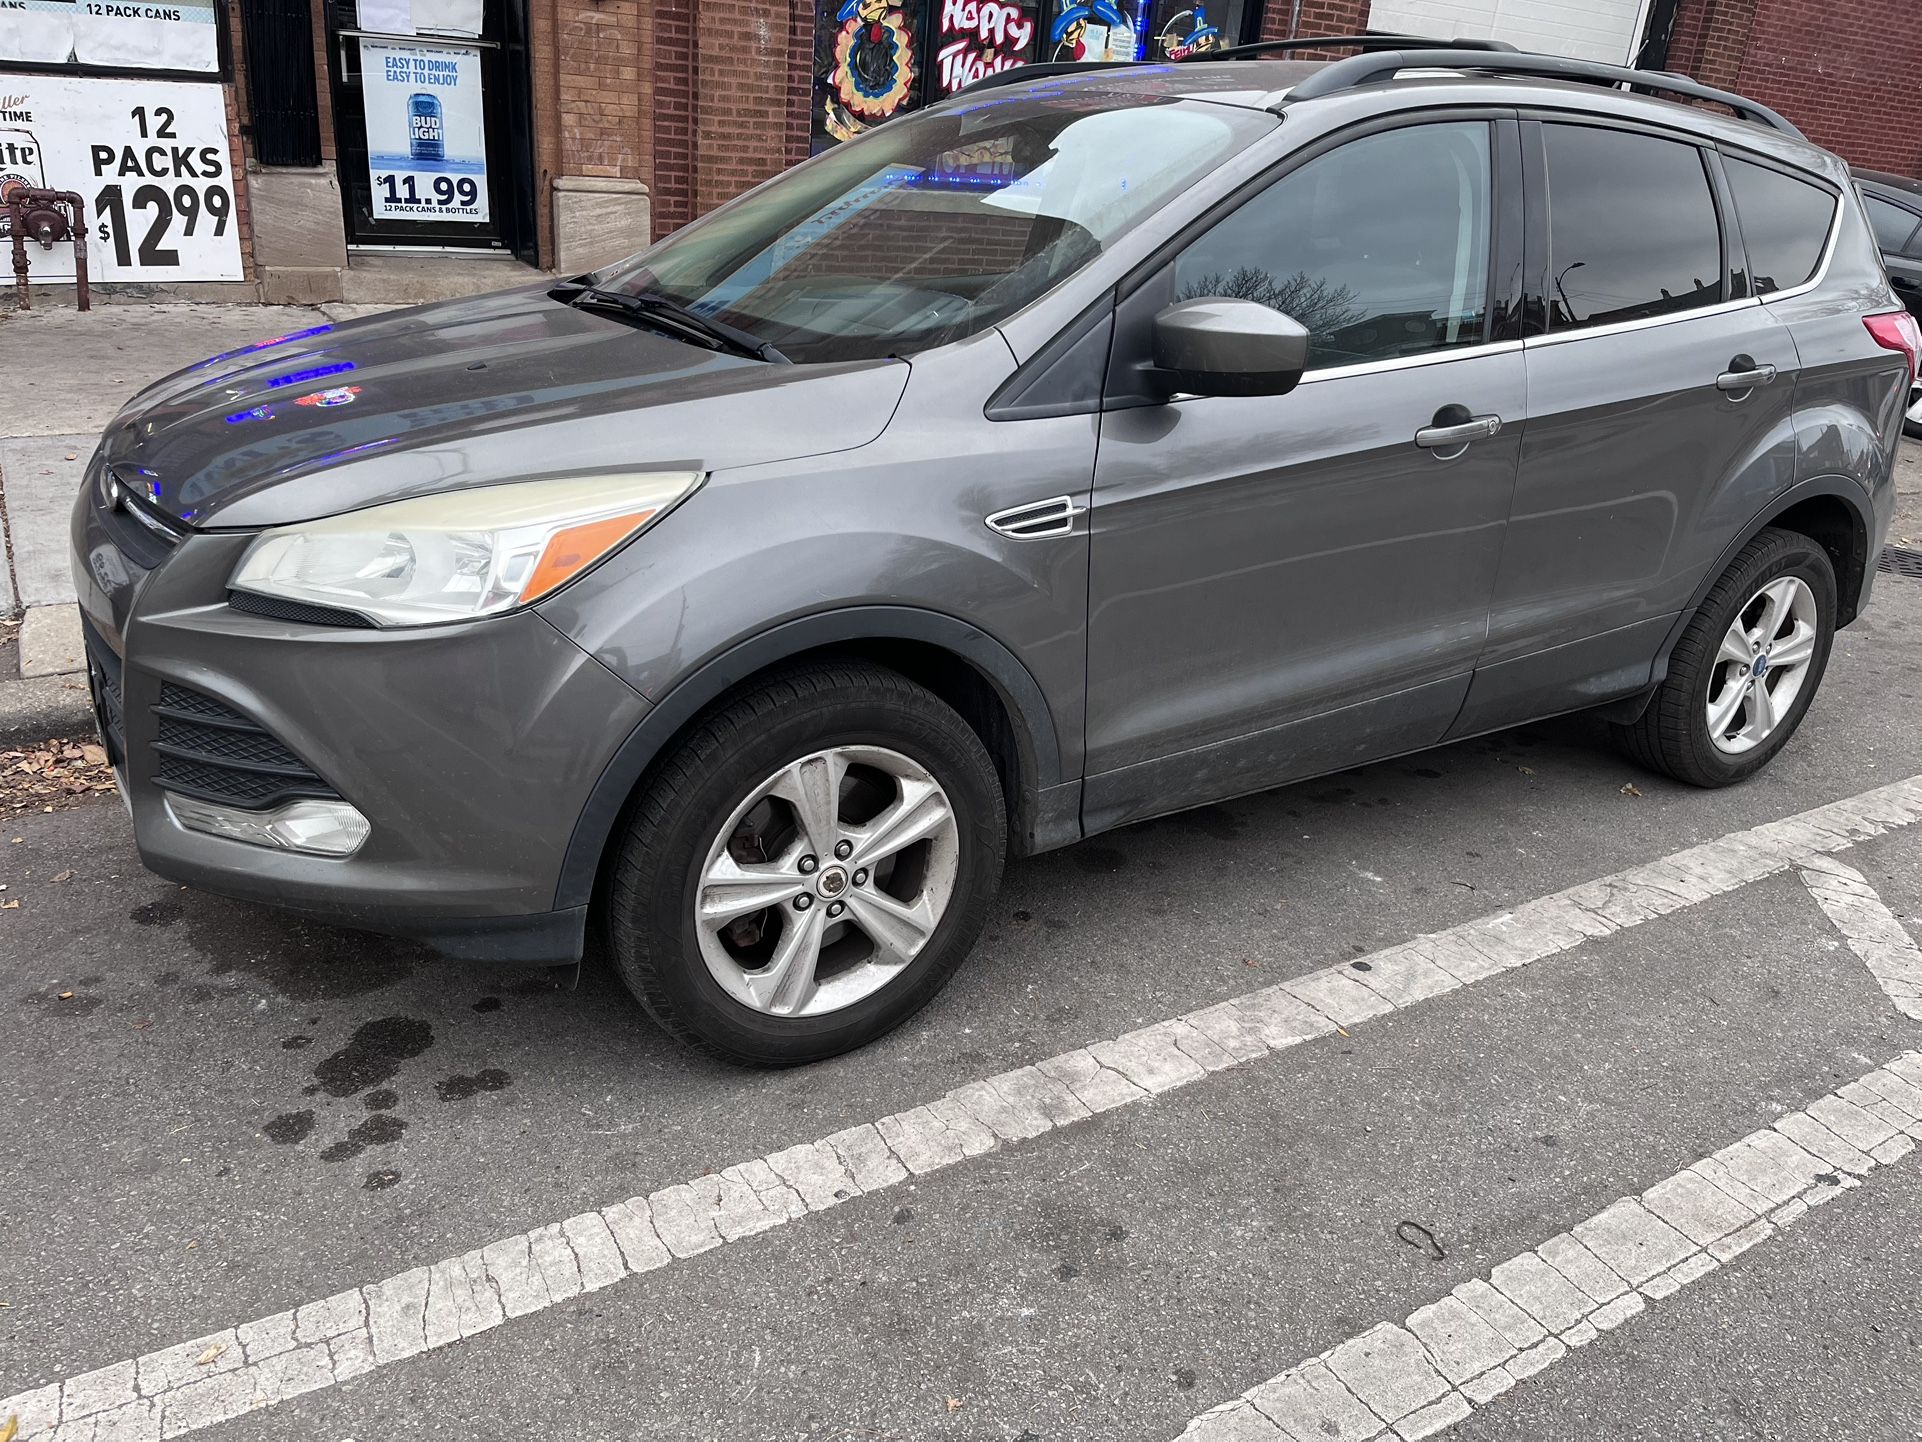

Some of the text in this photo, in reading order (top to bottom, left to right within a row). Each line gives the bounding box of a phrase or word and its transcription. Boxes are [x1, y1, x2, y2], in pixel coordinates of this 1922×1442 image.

[86, 3, 181, 21] 12 PACK CANS
[385, 56, 458, 74] EASY TO DRINK
[386, 69, 458, 86] EASY TO ENJOY
[0, 110, 33, 123] TIME
[131, 106, 177, 139] 12
[412, 115, 440, 129] BUD
[410, 127, 443, 140] LIGHT
[90, 144, 223, 178] PACKS
[376, 174, 478, 207] $11.99
[384, 204, 479, 215] 12 PACK CANS & BOTTLES
